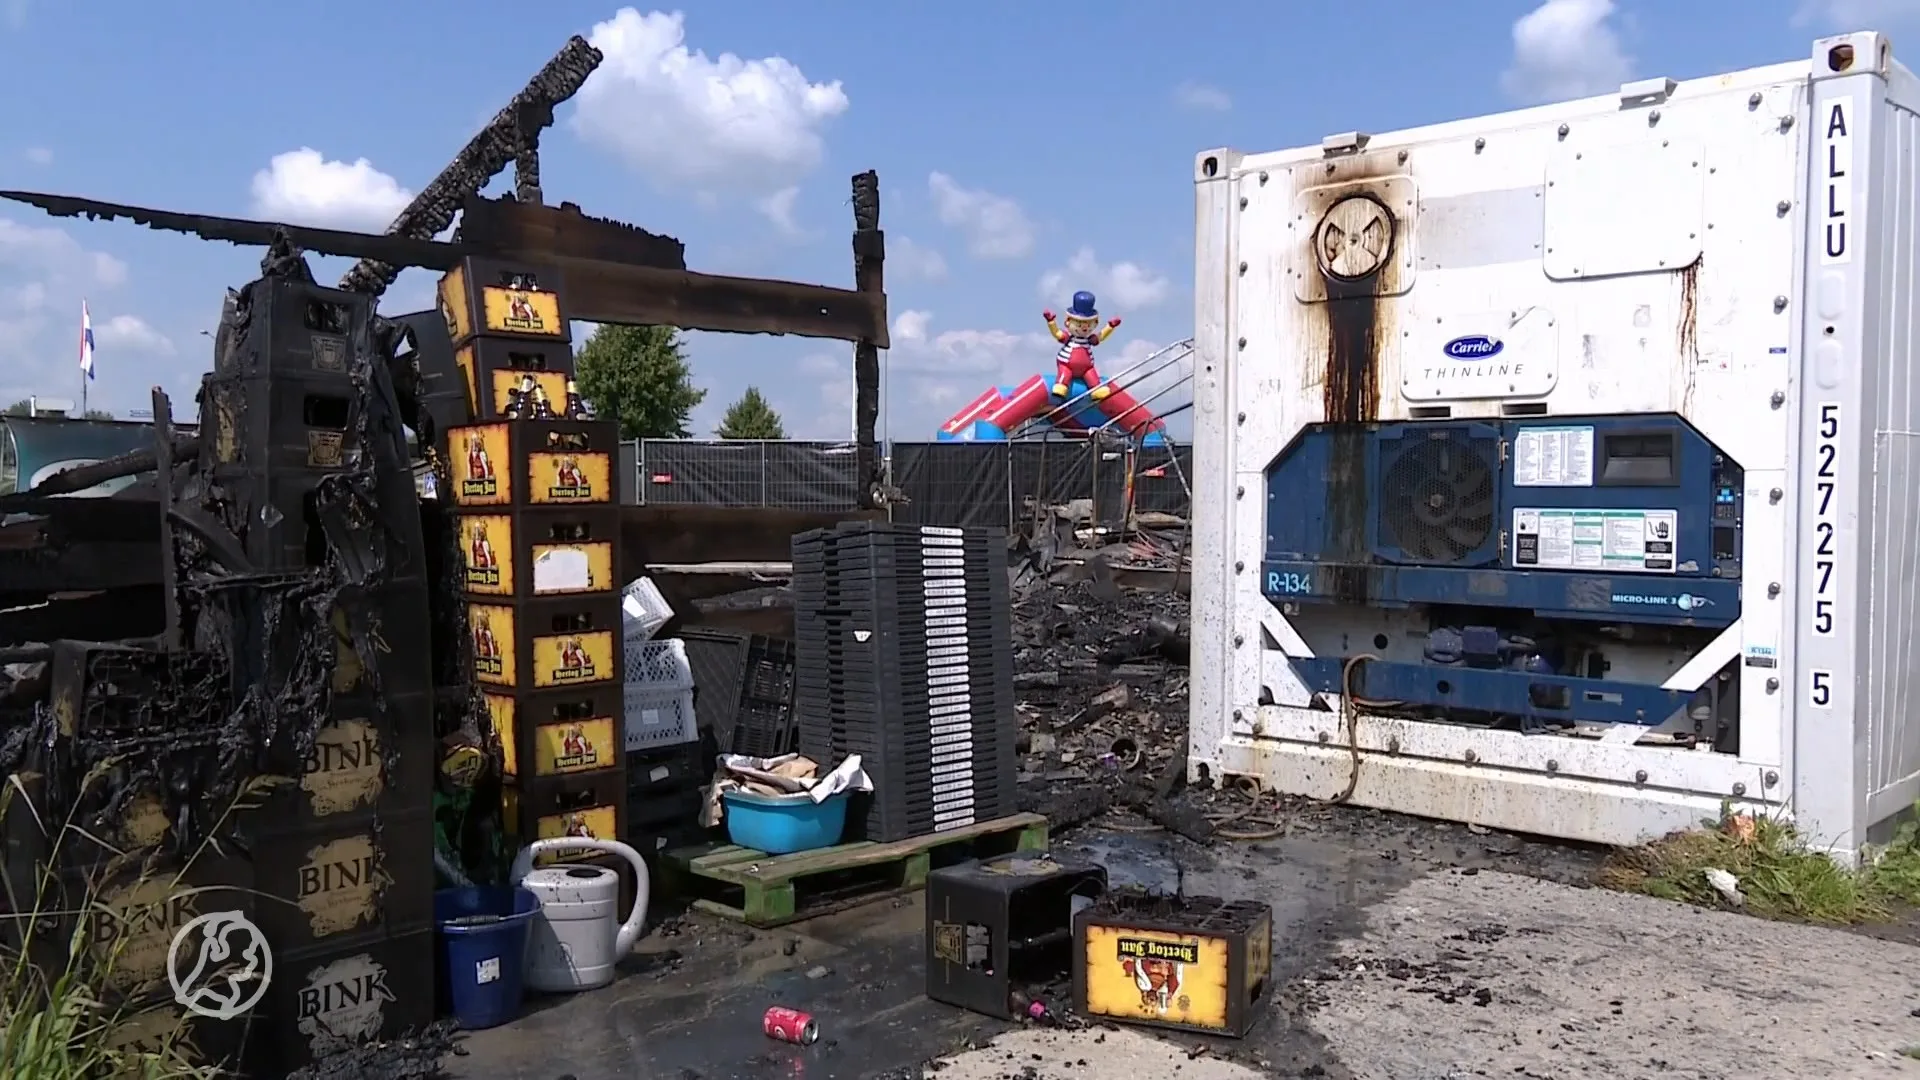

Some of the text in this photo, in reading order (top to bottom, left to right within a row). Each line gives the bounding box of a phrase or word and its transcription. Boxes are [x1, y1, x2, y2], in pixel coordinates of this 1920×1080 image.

[1827, 104, 1847, 258] ALLU
[1451, 340, 1494, 354] Carrier
[1424, 363, 1524, 379] THINLINE
[1815, 405, 1838, 634] 527275
[1268, 571, 1311, 594] R-134
[1612, 594, 1668, 605] MICRO-LINK
[1812, 672, 1830, 706] 5
[303, 738, 381, 775] BINK
[301, 856, 393, 896] BINK
[94, 894, 199, 942] BINK
[1121, 941, 1194, 961] Hertog Jan
[302, 974, 396, 1019] BINK
